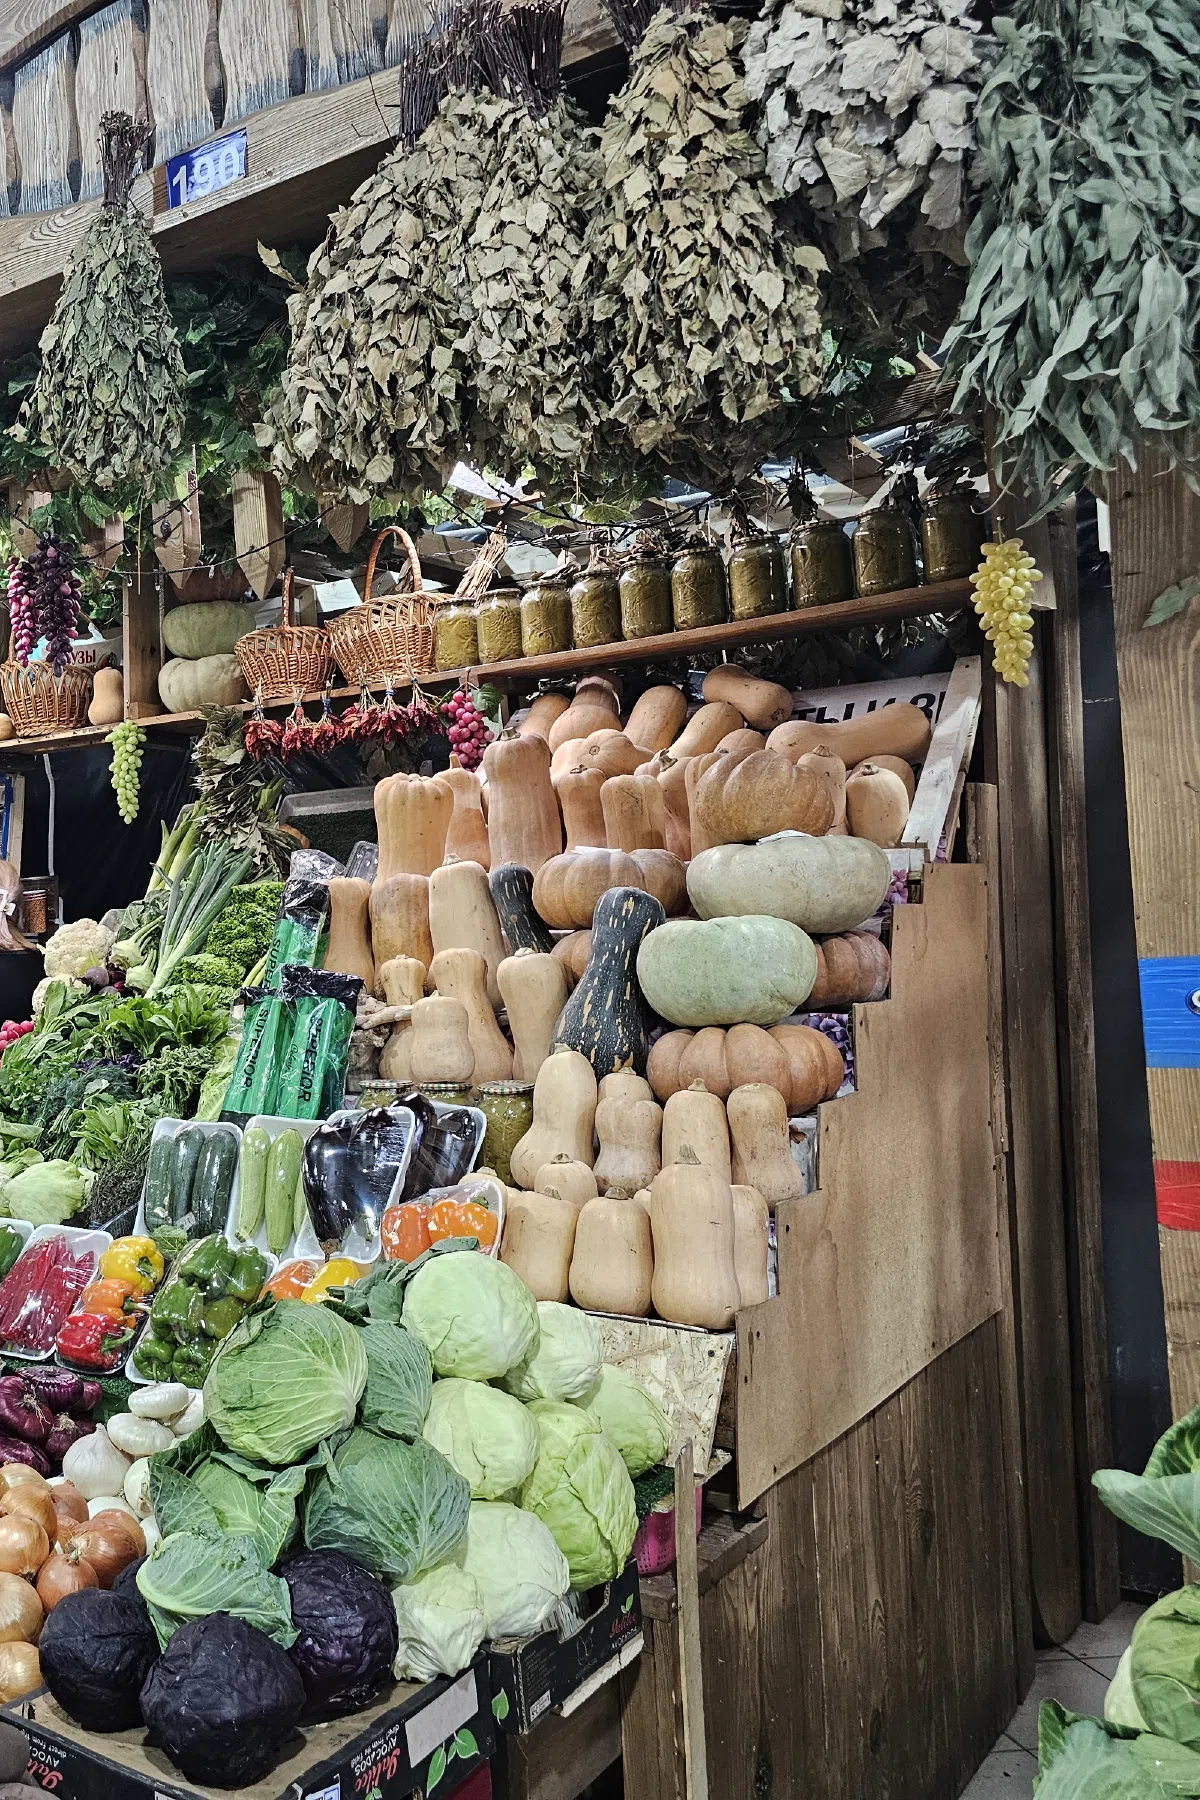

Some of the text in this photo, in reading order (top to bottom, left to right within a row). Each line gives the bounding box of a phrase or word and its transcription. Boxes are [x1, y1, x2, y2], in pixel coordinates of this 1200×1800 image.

[172, 146, 240, 206] 190
[243, 1008, 270, 1088] SUPERIOR
[297, 1016, 324, 1102] SUPERIOR
[29, 1745, 60, 1768] AVOC
[32, 1735, 47, 1750] from
[48, 1744, 67, 1759] direct
[354, 1735, 398, 1777] AVOCADOS
